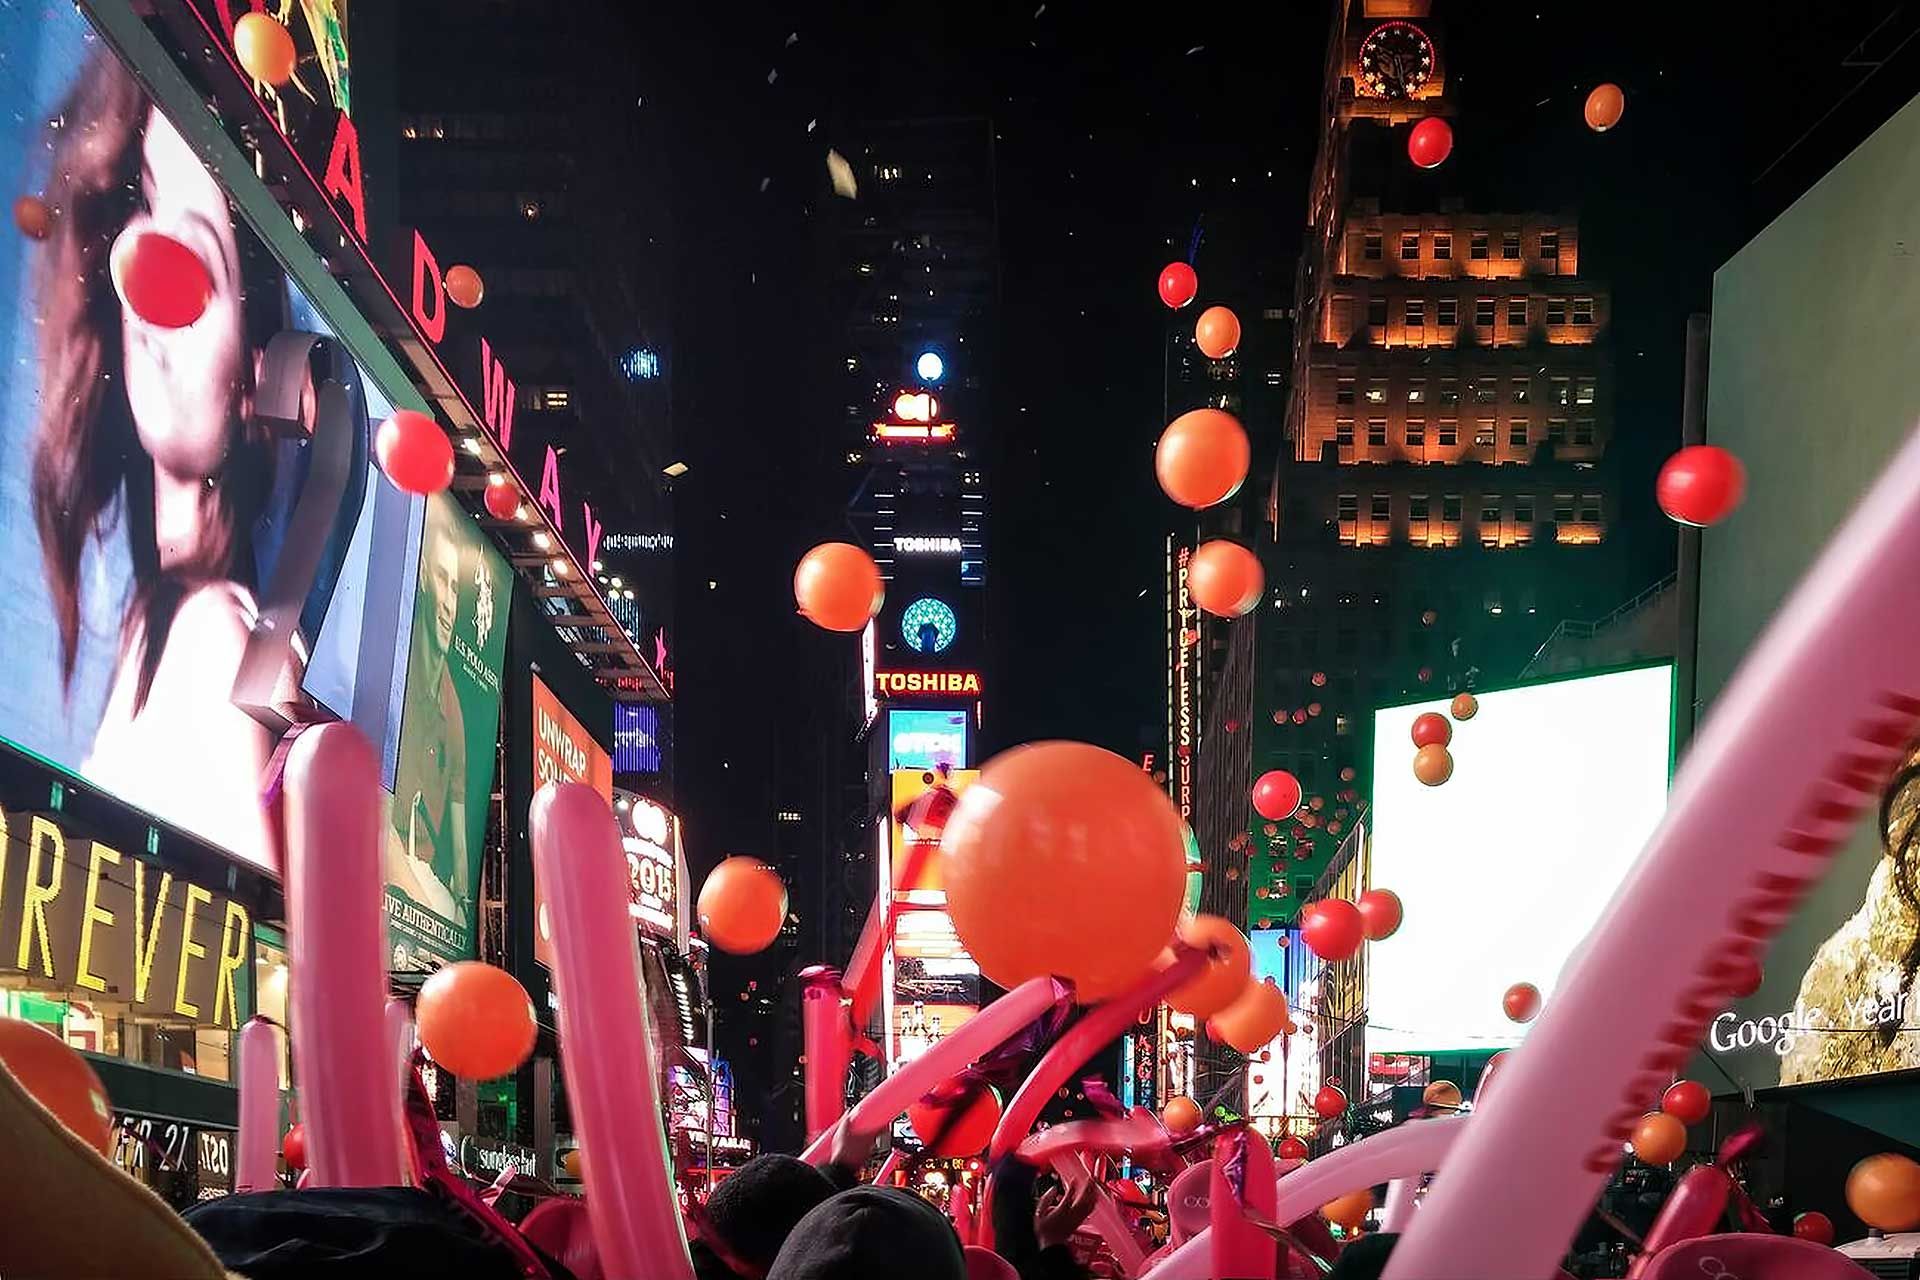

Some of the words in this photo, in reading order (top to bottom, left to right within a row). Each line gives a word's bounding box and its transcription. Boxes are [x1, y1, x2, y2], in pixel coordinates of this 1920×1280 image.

[213, 0, 602, 578] ADWAY
[894, 537, 962, 552] TOSHIBA
[876, 673, 979, 692] TOSHIBA
[538, 705, 587, 780] UNWRAP
[627, 854, 672, 902] 2015
[1711, 1007, 1823, 1056] Google
[1845, 992, 1909, 1029] Year
[158, 1123, 189, 1172] 21
[521, 1149, 537, 1178] hut
